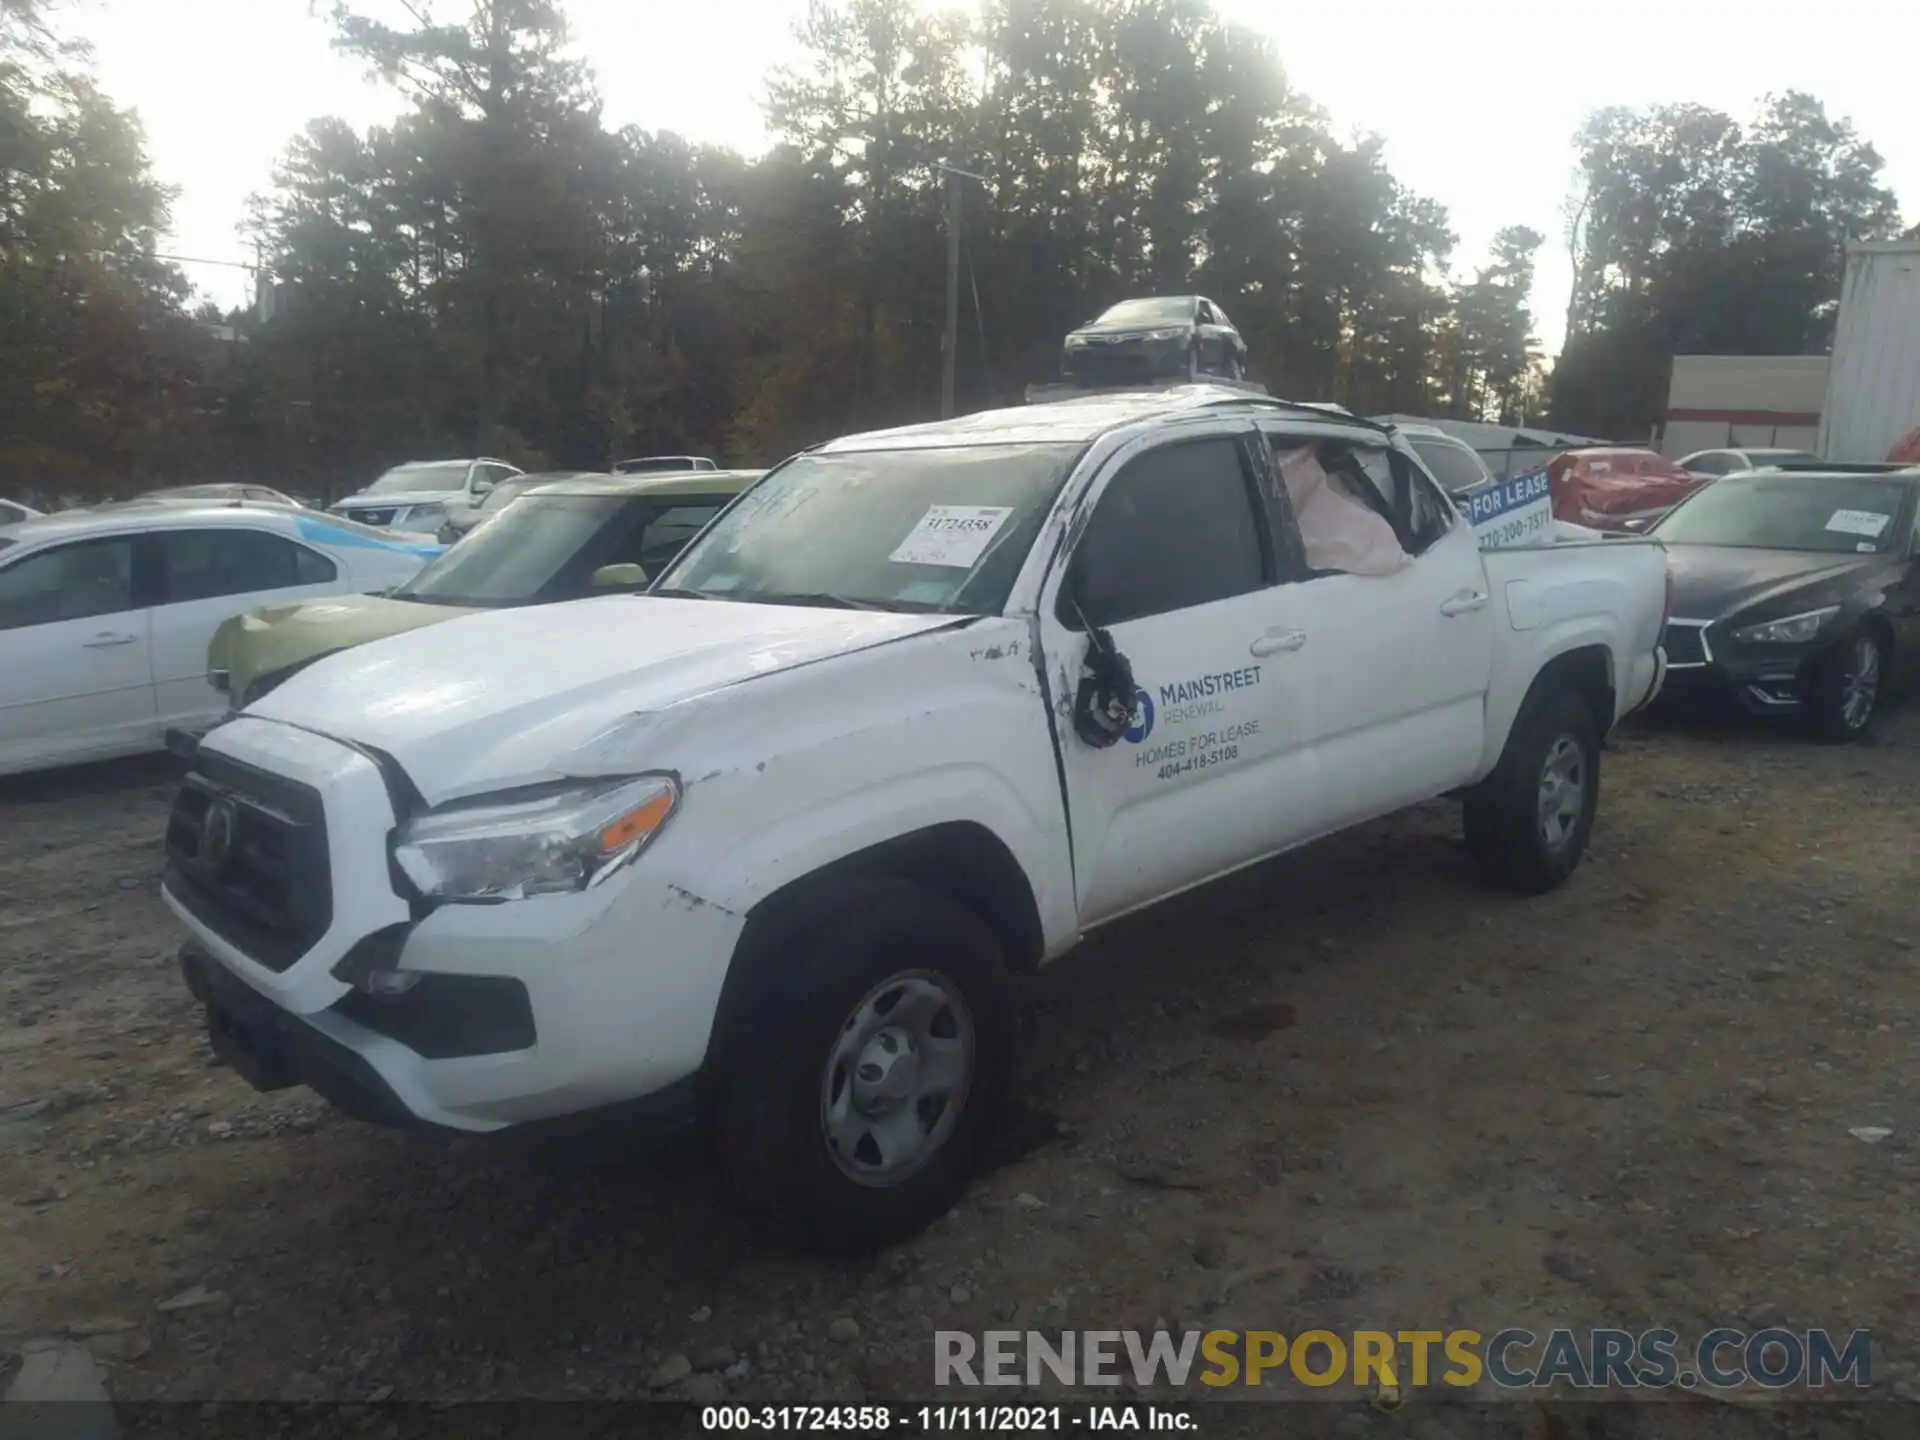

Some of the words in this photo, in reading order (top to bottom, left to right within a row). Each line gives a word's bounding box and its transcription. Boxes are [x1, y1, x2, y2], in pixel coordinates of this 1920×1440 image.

[1473, 490, 1501, 518] FOR
[1506, 472, 1548, 503] LEASE
[1160, 665, 1262, 706] MAINSTREET
[1164, 700, 1222, 725] RENEWAL
[1136, 740, 1186, 768] HOMES
[1190, 731, 1217, 752] FOR
[1221, 720, 1261, 745] LEASE
